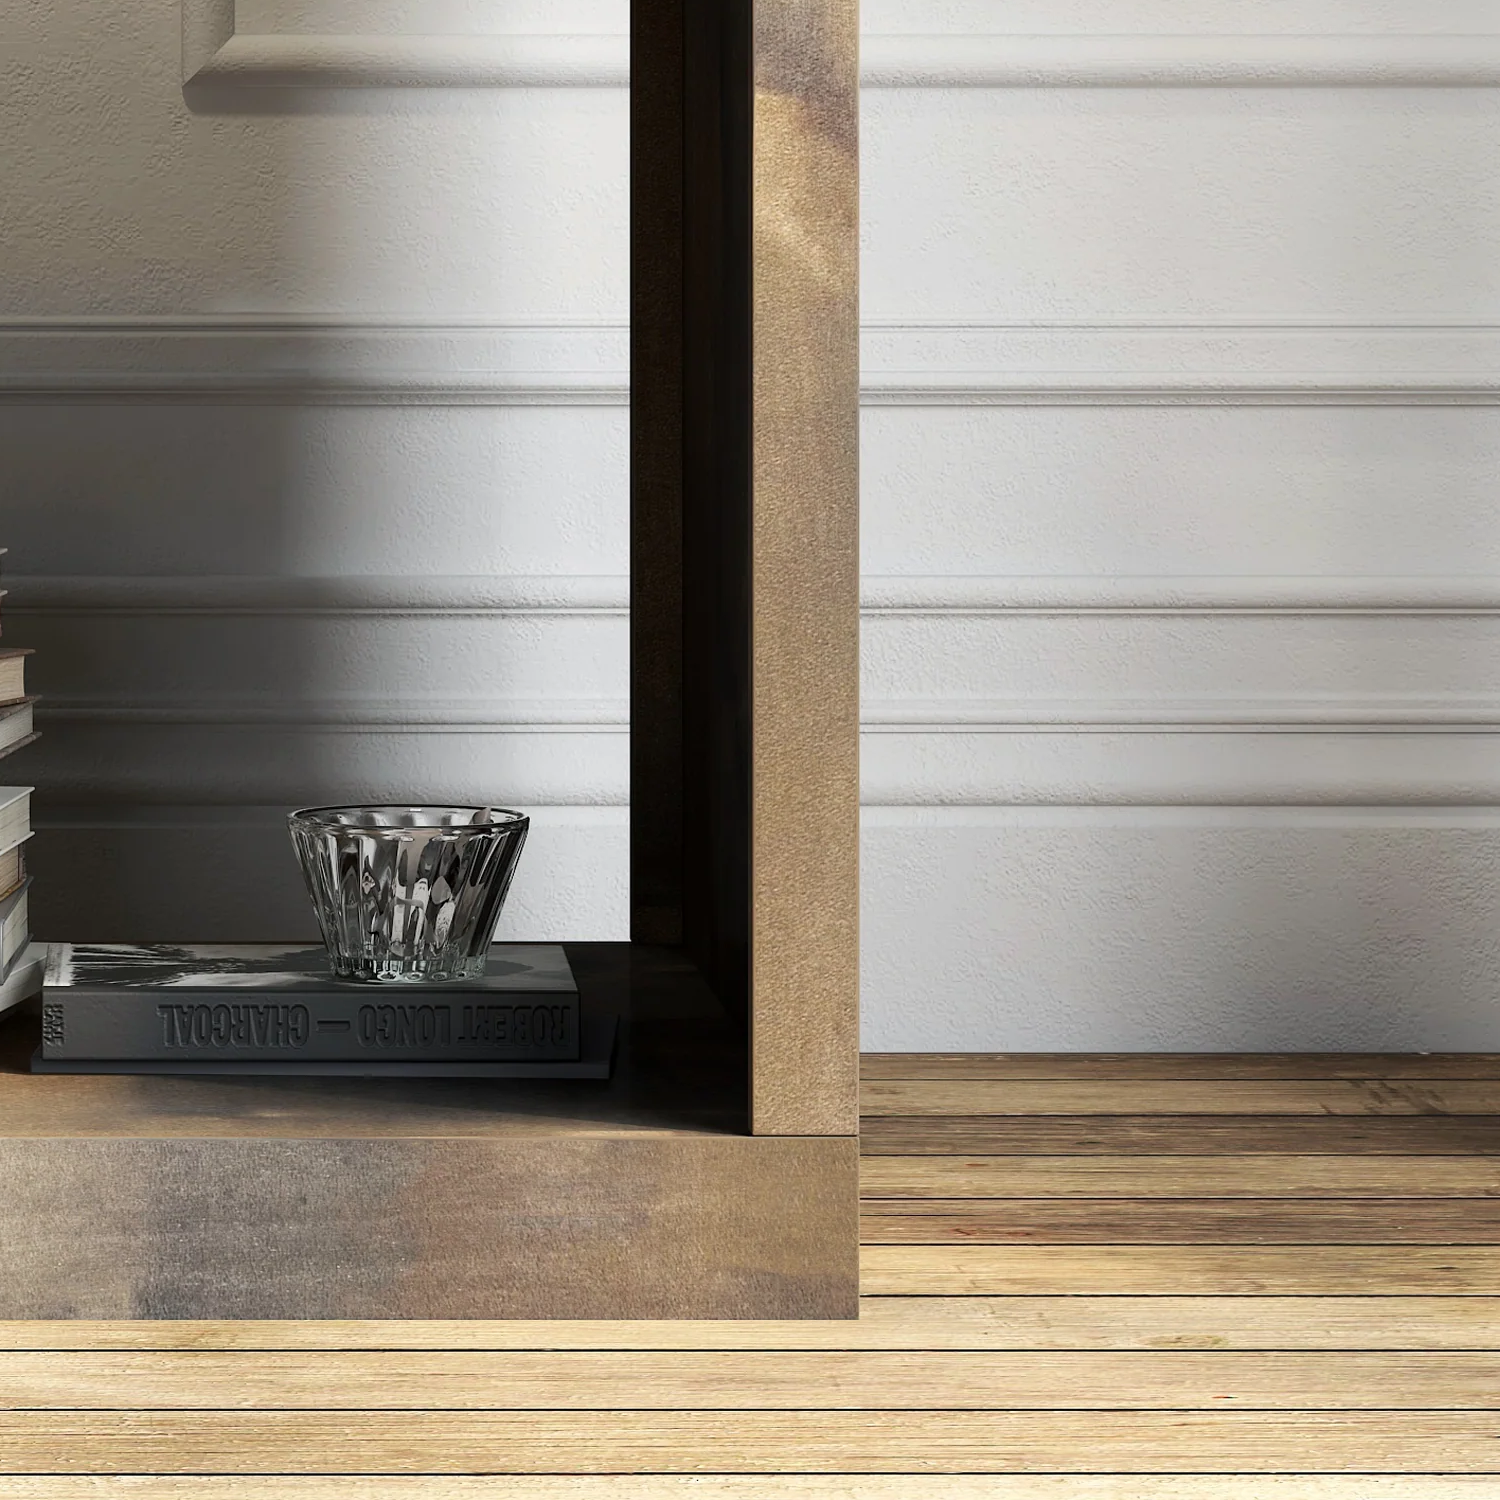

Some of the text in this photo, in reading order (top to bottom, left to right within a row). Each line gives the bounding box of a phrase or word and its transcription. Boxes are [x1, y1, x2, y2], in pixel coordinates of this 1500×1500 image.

[157, 1003, 310, 1048] CHARCOAL
[357, 1004, 451, 1048] LONGO
[457, 1005, 572, 1048] ROBERT
